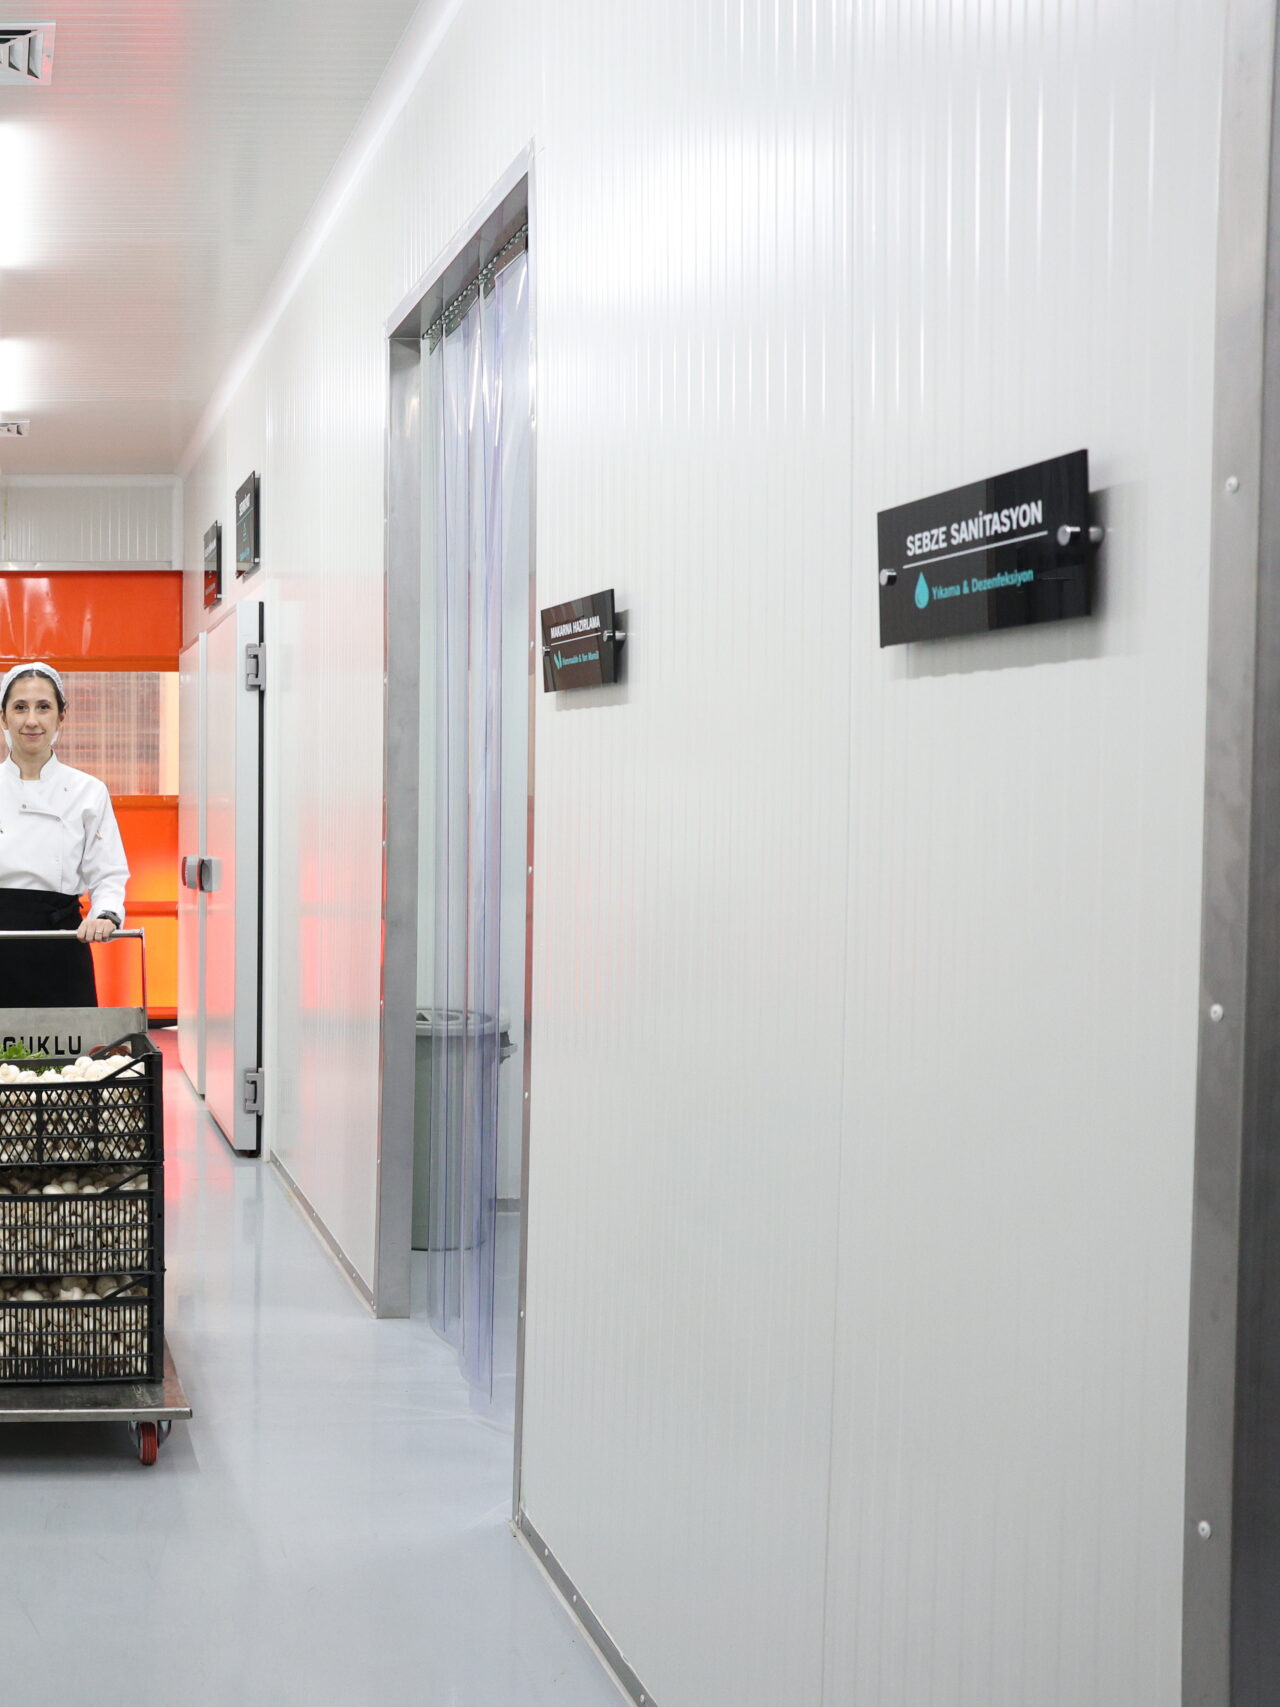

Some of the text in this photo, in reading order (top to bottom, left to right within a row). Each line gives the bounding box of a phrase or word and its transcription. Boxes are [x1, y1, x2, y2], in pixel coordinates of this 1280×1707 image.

[906, 499, 1043, 557] SEBZE SANİTASYON
[932, 569, 1034, 600] Yıkama & Dezenfeksiyon
